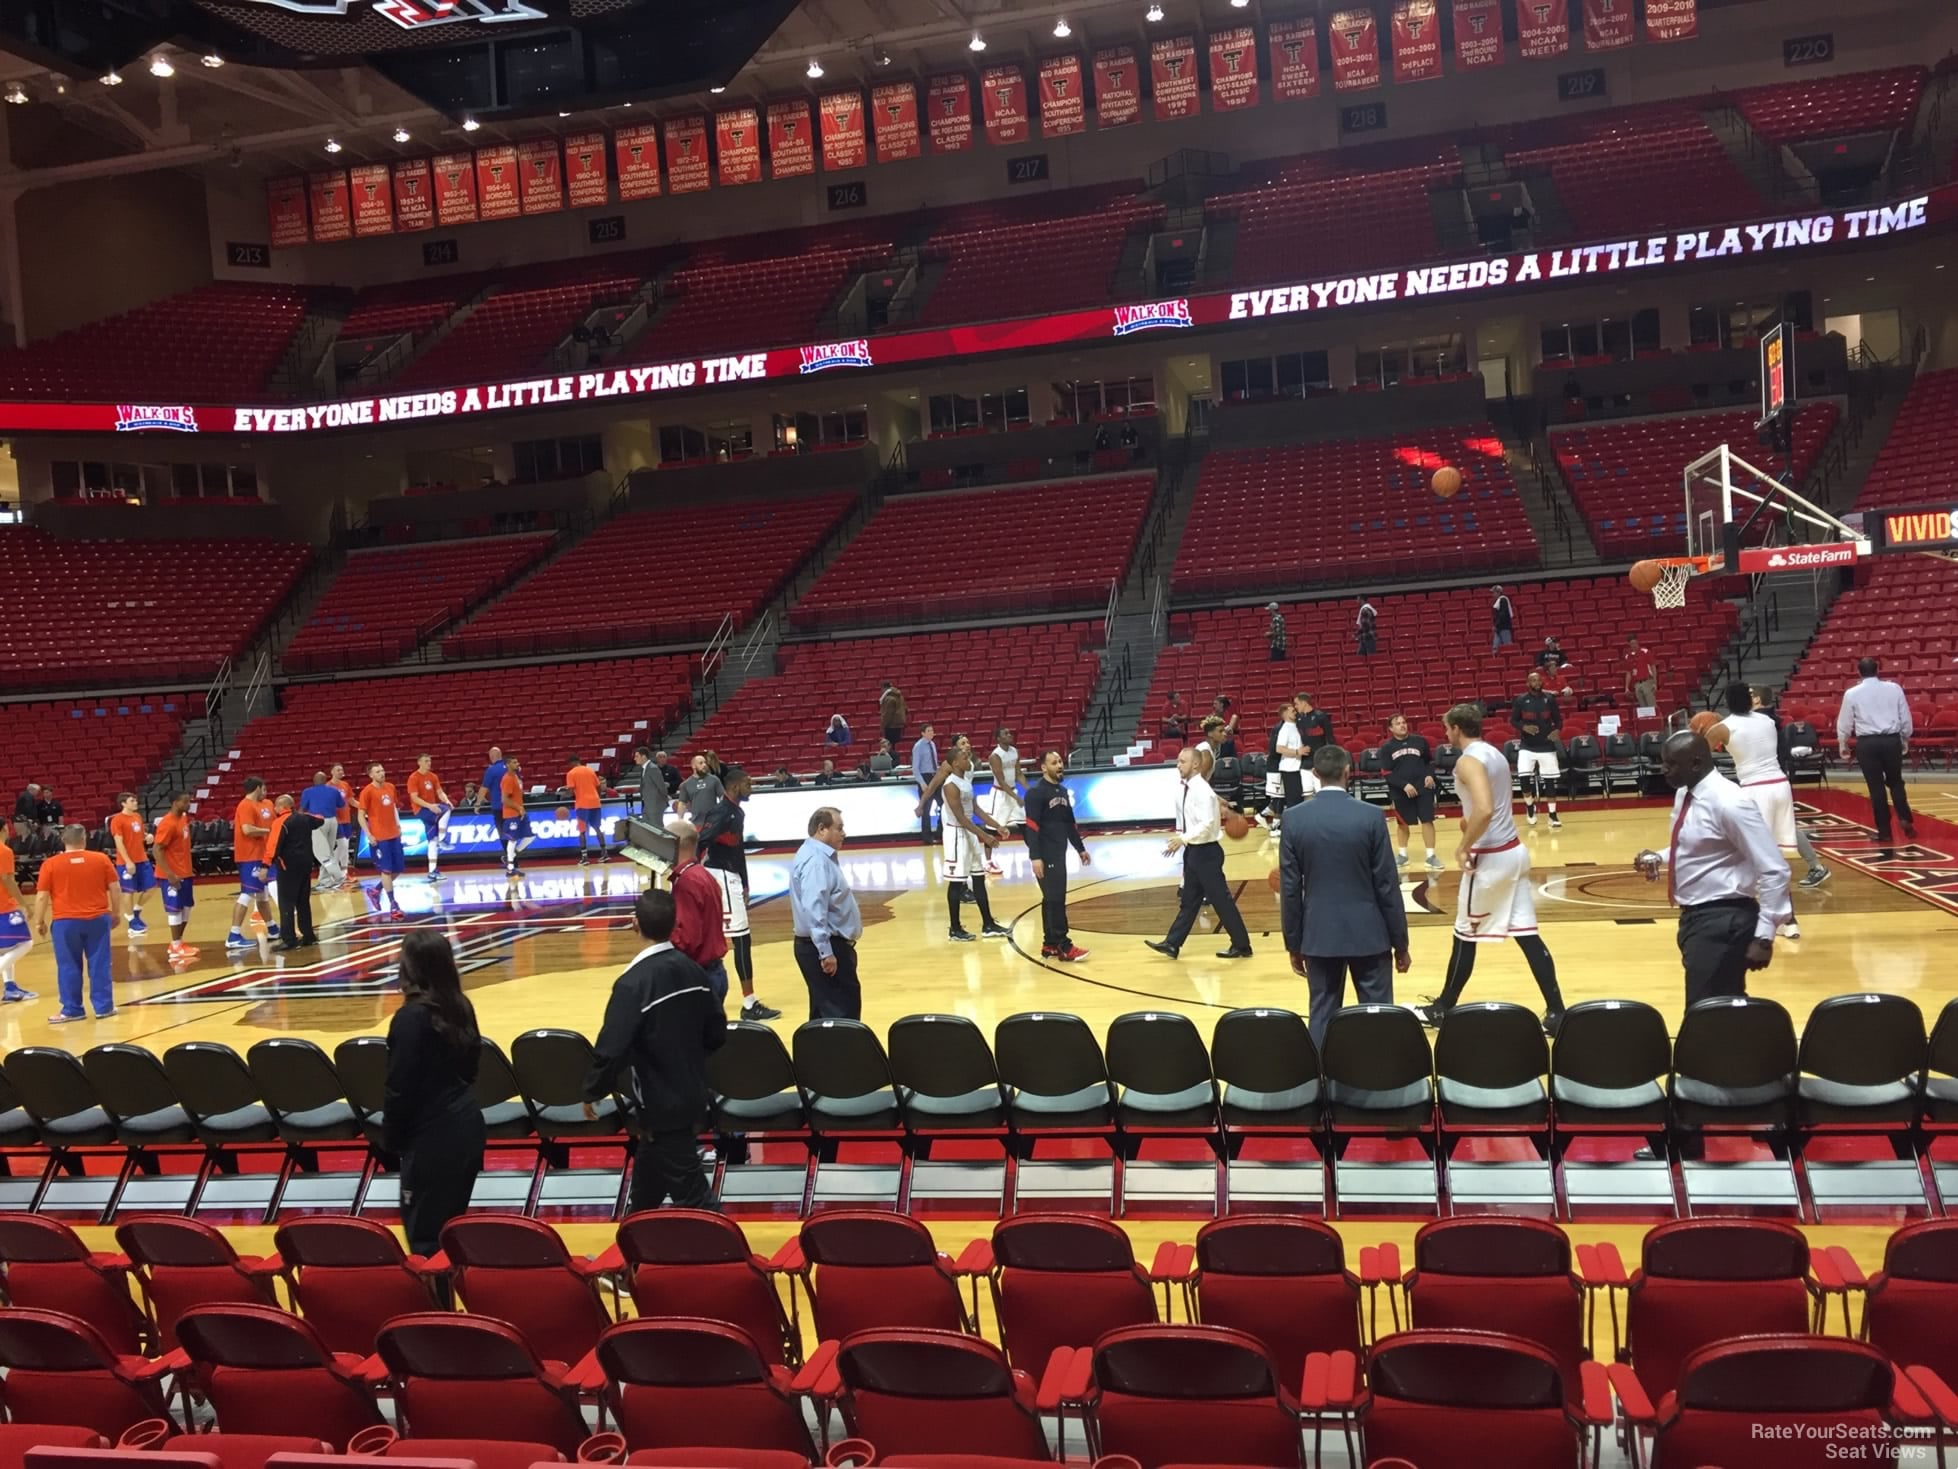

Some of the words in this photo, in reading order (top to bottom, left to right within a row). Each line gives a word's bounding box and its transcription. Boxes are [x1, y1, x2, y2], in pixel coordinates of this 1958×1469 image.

[1648, 0, 1695, 14] 2009-2010
[1530, 35, 1558, 46] NCAA
[1522, 45, 1556, 57] SWEET
[1790, 40, 1828, 61] 220
[1412, 57, 1433, 68] PLACE
[1466, 53, 1493, 65] NCAA
[1283, 64, 1306, 73] NCAA
[1347, 68, 1366, 79] NCAA
[1216, 71, 1253, 84] CHAMPIONS
[1282, 71, 1309, 81] SWEET
[1335, 75, 1379, 89] TOURNAMENT
[1155, 83, 1197, 97] CONFERENCE
[1156, 78, 1195, 91] SOUTHWEST
[1278, 78, 1315, 89] SIXTEEN
[1568, 75, 1597, 94] 219
[1157, 91, 1197, 104] CHAMPIONS
[1221, 87, 1250, 98] CLASSIC
[1043, 97, 1081, 110] CHAMPIONS
[995, 107, 1017, 118] NCAA
[1351, 107, 1377, 127] 218
[1016, 159, 1041, 178] 217
[835, 187, 859, 206] 216
[596, 222, 618, 239] 215
[236, 246, 262, 263] 213
[1229, 273, 1398, 321] EVERYONE
[1405, 257, 1509, 297] NEEDS
[1514, 252, 1542, 281] A
[1549, 237, 1667, 279] LITTLE
[1674, 216, 1834, 262] PLAYING
[1844, 196, 1928, 239] TIME
[233, 398, 374, 432] EVERYONE
[379, 392, 456, 420] NEEDS
[462, 389, 496, 412] A
[494, 379, 573, 410] LITTLE
[578, 364, 697, 400] PLAYING
[702, 354, 767, 384] TIME
